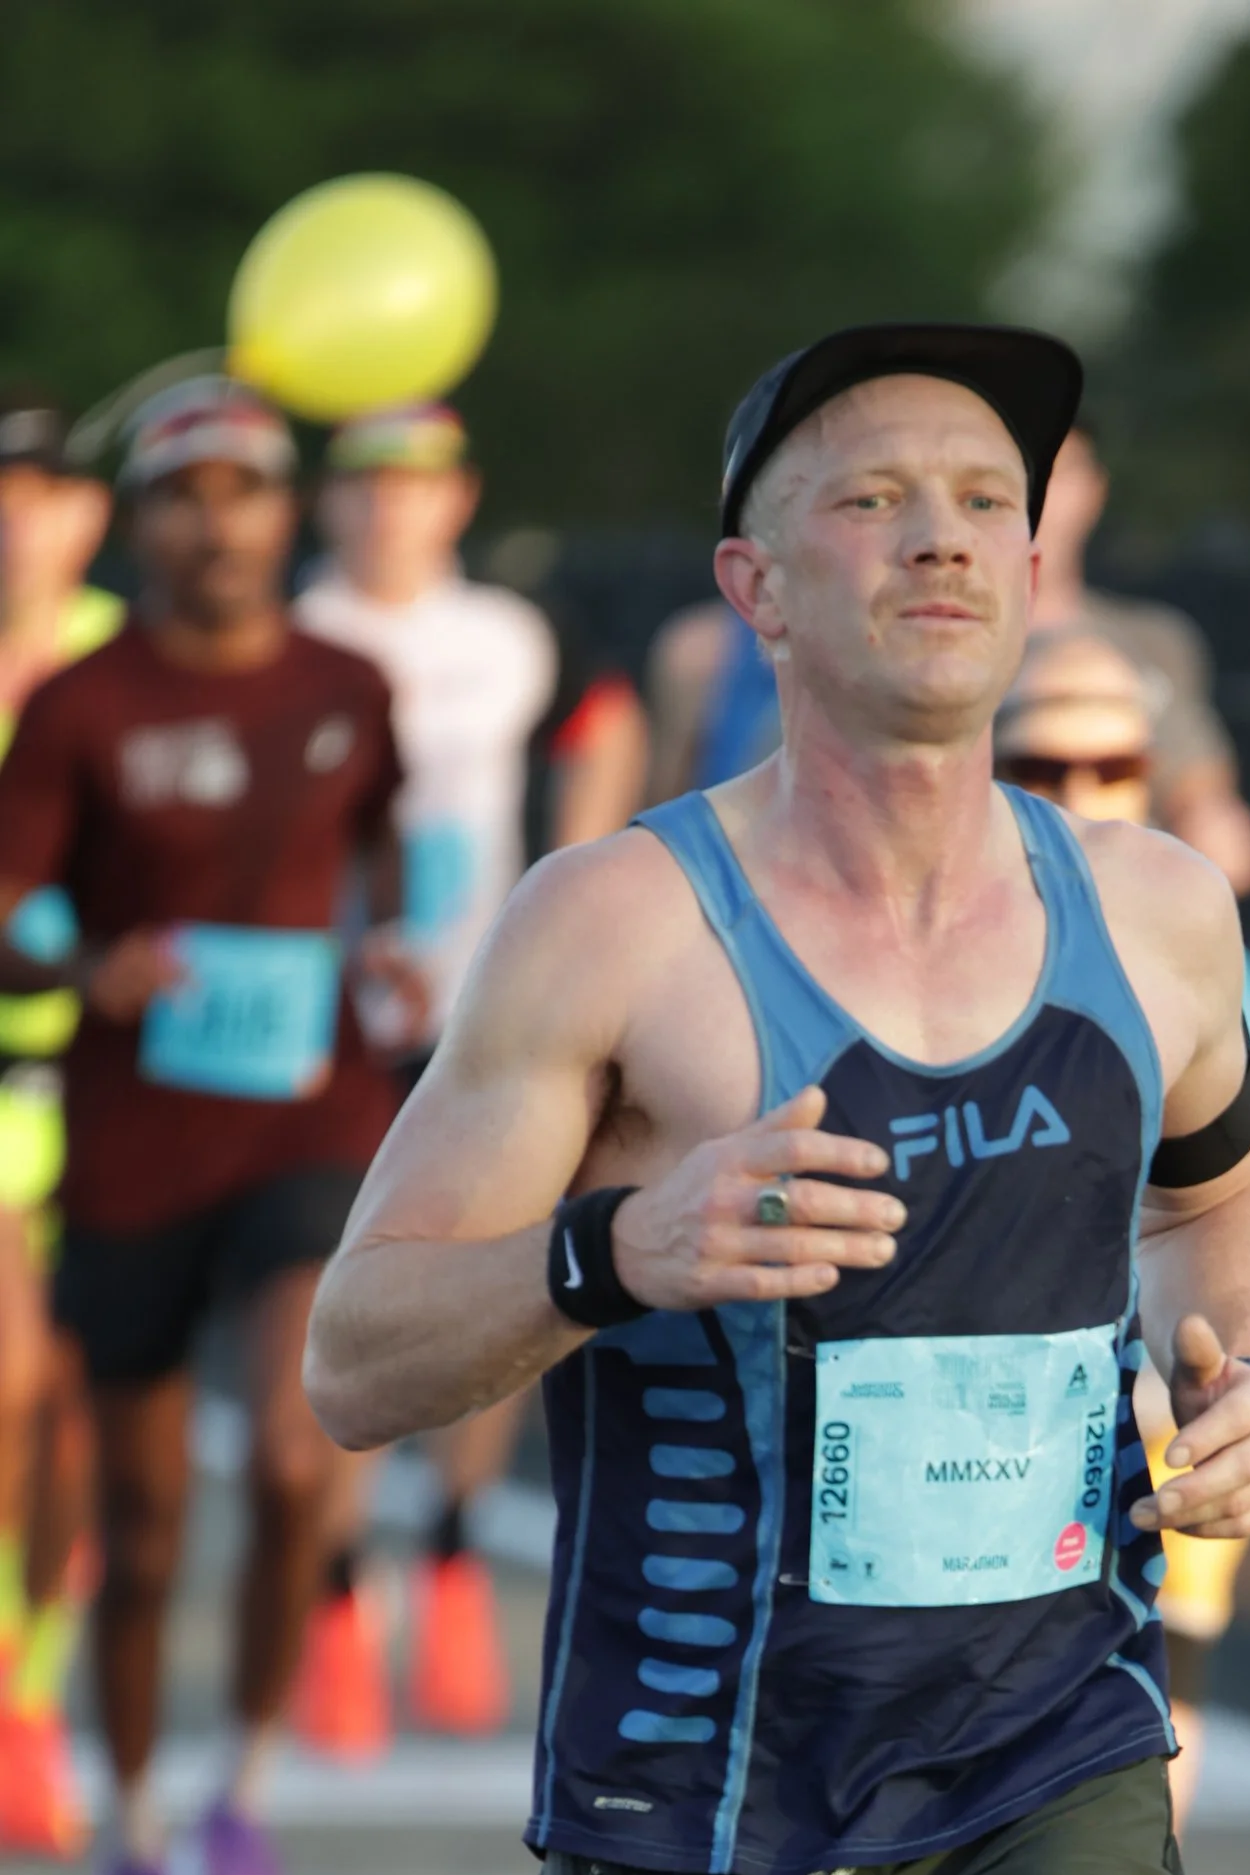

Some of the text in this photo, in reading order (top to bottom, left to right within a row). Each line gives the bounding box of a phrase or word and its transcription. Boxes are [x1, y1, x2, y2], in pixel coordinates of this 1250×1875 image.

[889, 1084, 1071, 1181] FILA
[819, 1421, 851, 1525] 12660
[925, 1458, 1031, 1483] MMXXV
[1082, 1403, 1106, 1509] 12660
